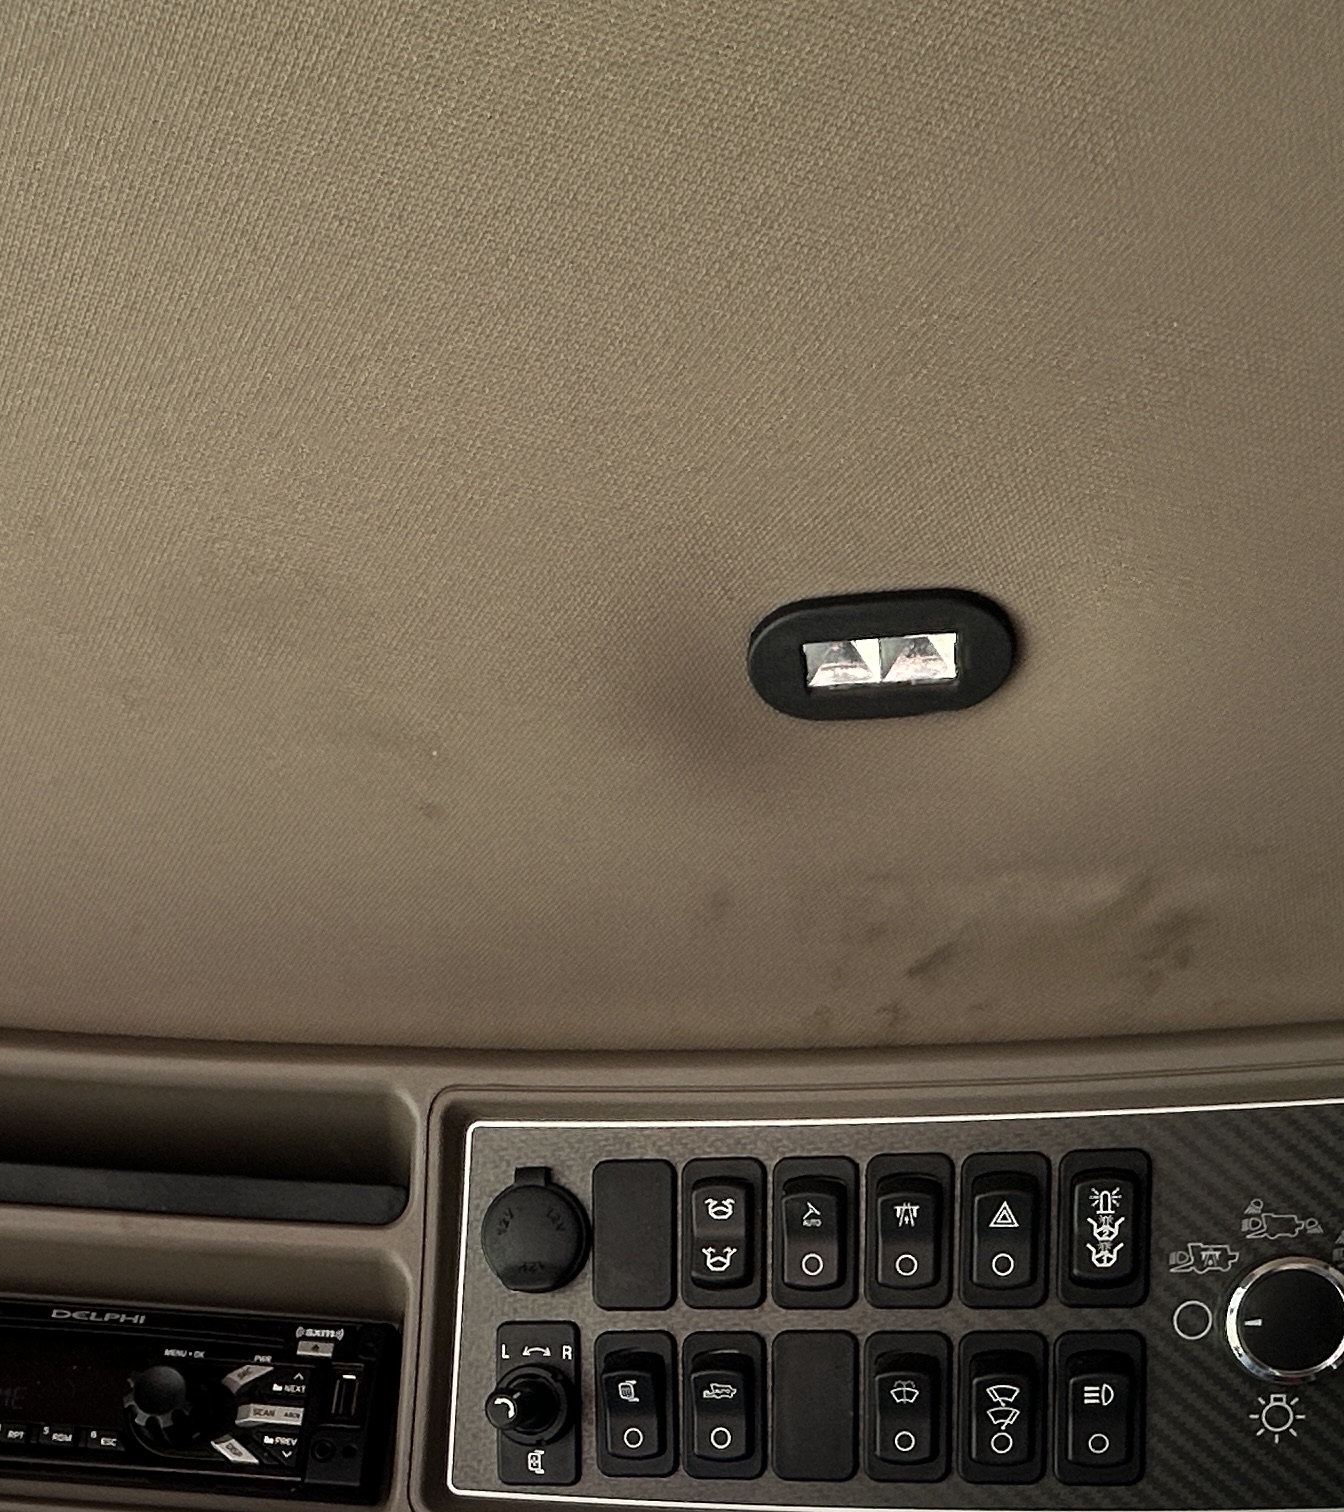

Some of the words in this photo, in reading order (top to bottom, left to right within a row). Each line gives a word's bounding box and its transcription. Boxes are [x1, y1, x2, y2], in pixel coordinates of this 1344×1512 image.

[51, 1309, 146, 1324] DELPHI
[164, 1349, 187, 1357] MENU
[194, 1350, 205, 1359] OK
[501, 1343, 510, 1359] L
[562, 1345, 573, 1360] R
[284, 1385, 306, 1393] NEXT
[253, 1408, 275, 1417] SCAN
[43, 1426, 50, 1435] 5
[100, 1437, 117, 1447] ESC
